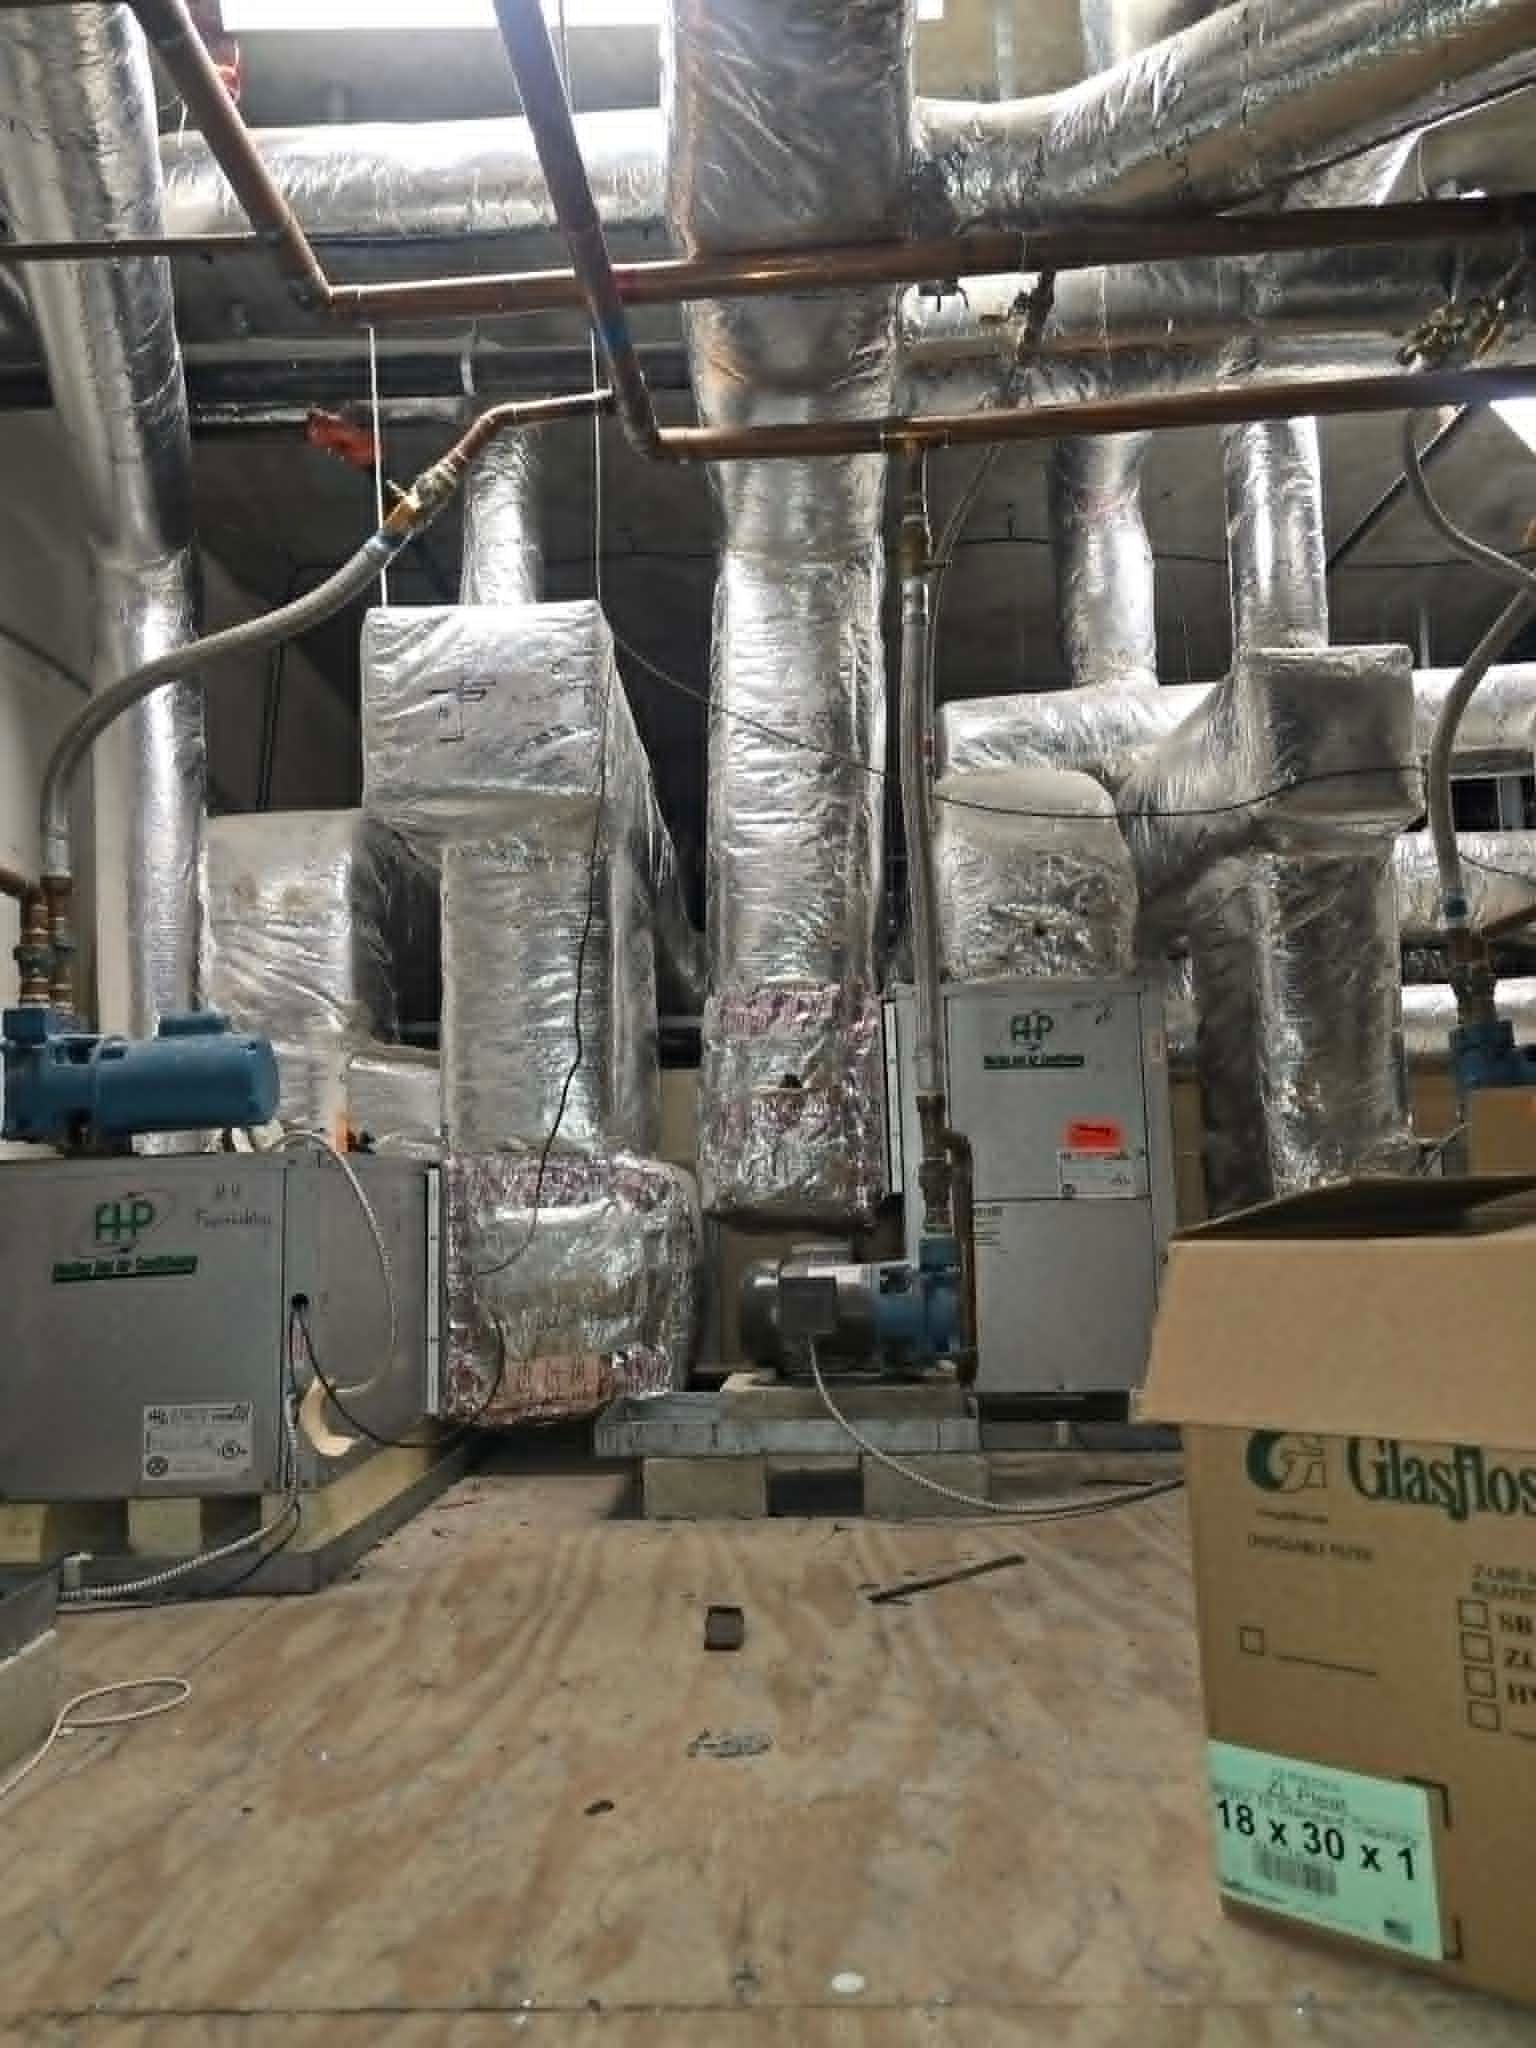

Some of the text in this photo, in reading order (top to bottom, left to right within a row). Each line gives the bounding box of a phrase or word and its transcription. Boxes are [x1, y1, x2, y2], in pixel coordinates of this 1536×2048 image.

[1216, 1799, 1256, 1837] 18
[1267, 1819, 1289, 1847] x
[1302, 1821, 1346, 1861] 30
[1360, 1844, 1383, 1873] x
[1397, 1847, 1415, 1882] 1
